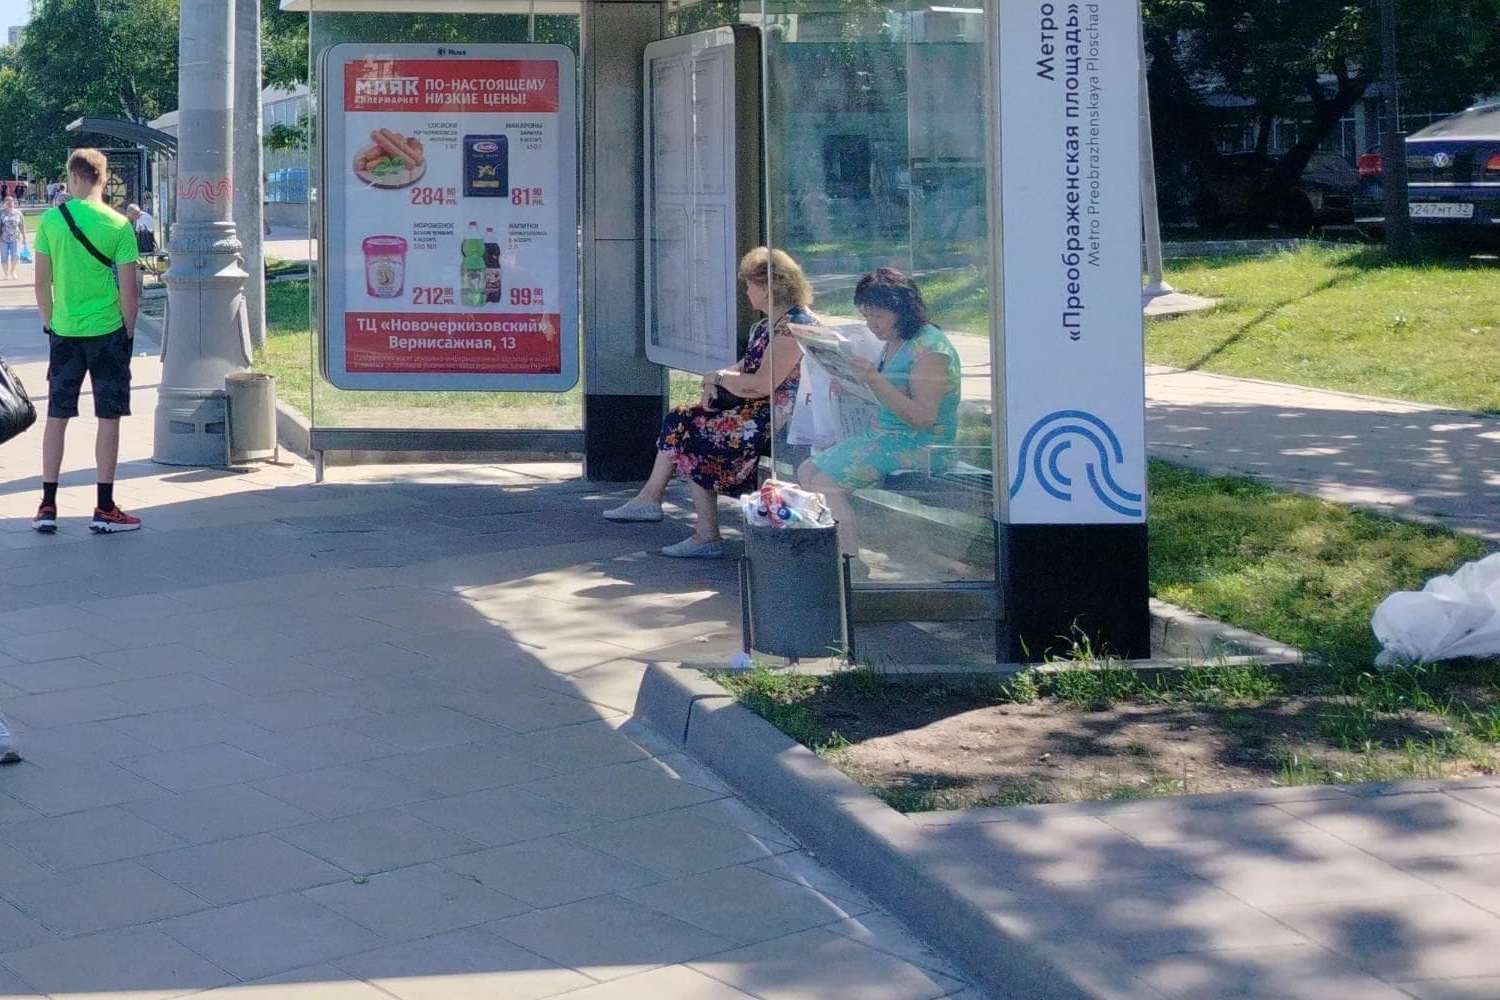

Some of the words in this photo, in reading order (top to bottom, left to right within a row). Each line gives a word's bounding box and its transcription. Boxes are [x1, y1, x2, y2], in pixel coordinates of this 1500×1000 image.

[1036, 3, 1057, 81] Метро
[1085, 3, 1100, 71] Ploschad
[1064, 3, 1082, 118] площадь»
[356, 80, 419, 96] МАЯК
[425, 78, 546, 92] ПО-НАСТОЯЩЕМУ
[425, 92, 479, 105] НИЗКИЕ
[483, 92, 527, 107] ЦЕНЫ!
[1086, 76, 1103, 214] Preobrazhenskaya
[411, 187, 444, 205] 284
[511, 187, 530, 205] 81
[1062, 125, 1084, 342] «Преображенская
[1087, 219, 1101, 267] Metro
[413, 287, 444, 305] 212
[510, 287, 532, 305] 99
[357, 319, 377, 333] ТЦ
[381, 317, 548, 334] «Новочеркизовский»
[389, 335, 497, 351] Вернисажная,
[501, 336, 516, 349] 13
